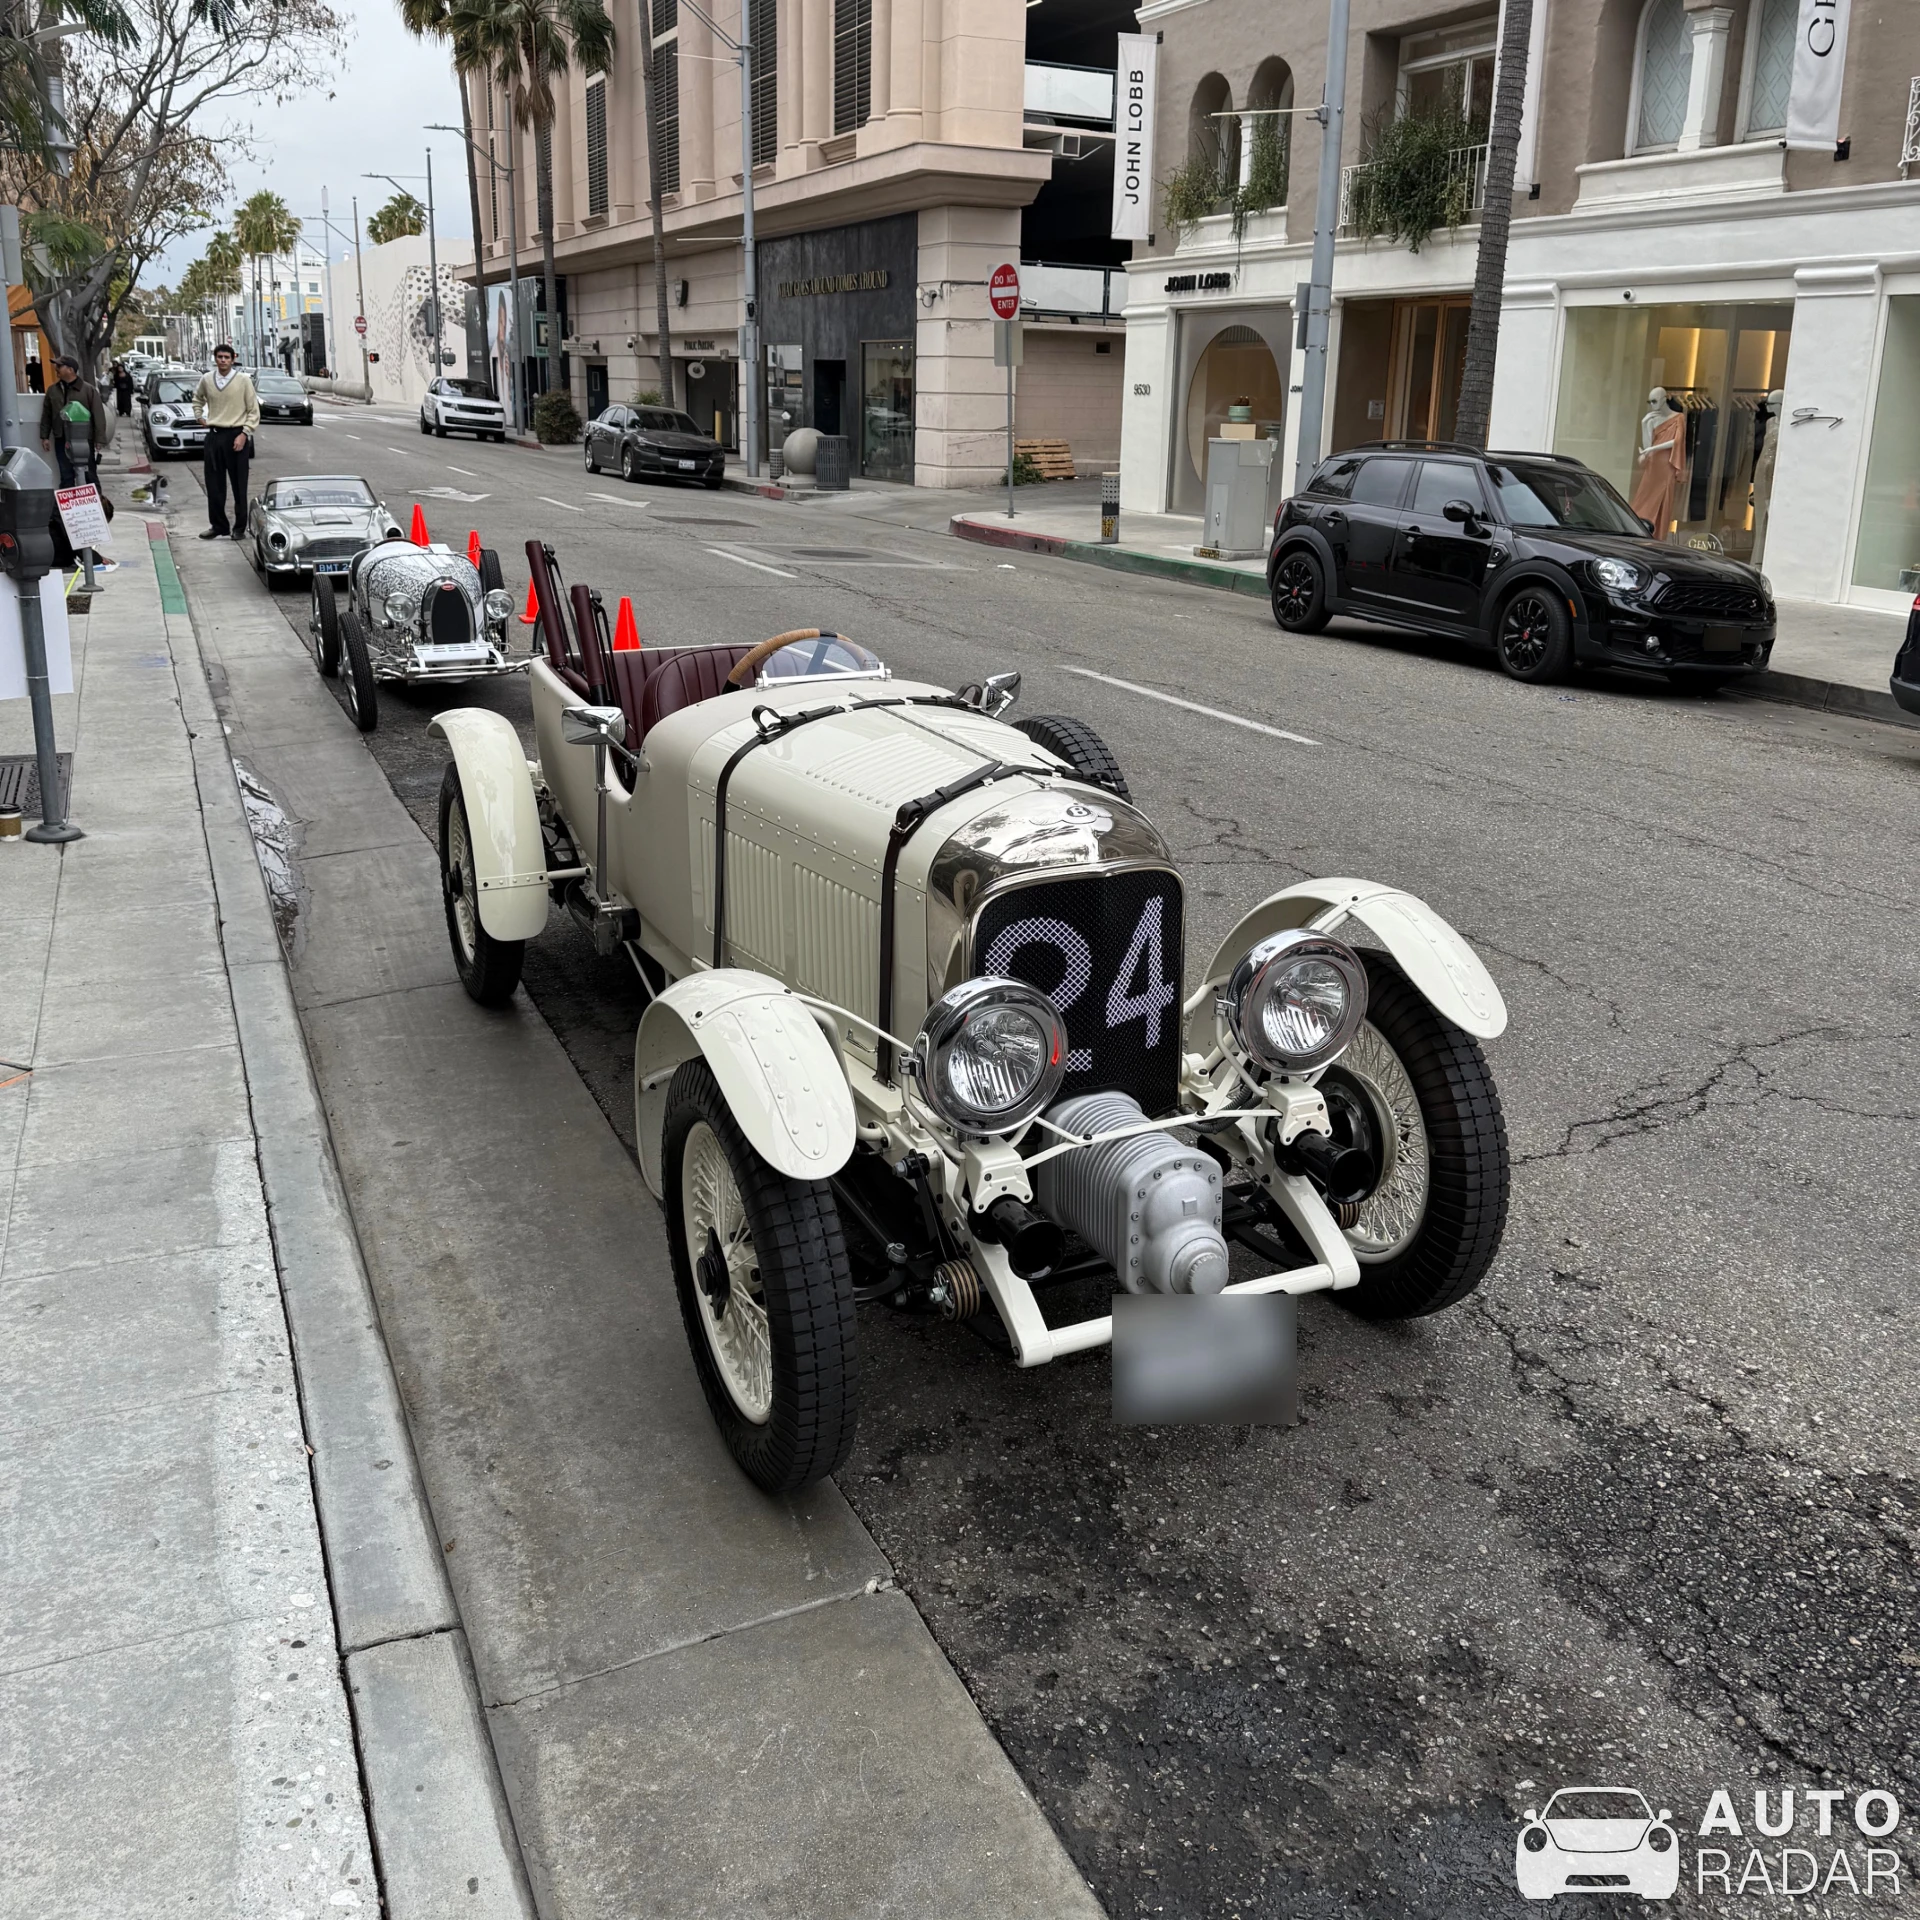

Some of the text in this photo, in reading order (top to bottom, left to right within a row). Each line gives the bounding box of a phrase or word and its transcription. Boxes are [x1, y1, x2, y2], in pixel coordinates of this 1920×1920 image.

[1125, 70, 1143, 205] JOHN LOBB
[835, 273, 858, 292] COMES
[859, 269, 888, 290] AROUND
[995, 273, 1016, 285] DO NOT
[1164, 272, 1231, 293] JOHN LOBB
[997, 299, 1015, 310] ENTER
[57, 487, 94, 500] TOW-AWAY
[60, 496, 98, 510] NO PARKING
[319, 563, 339, 573] BMT
